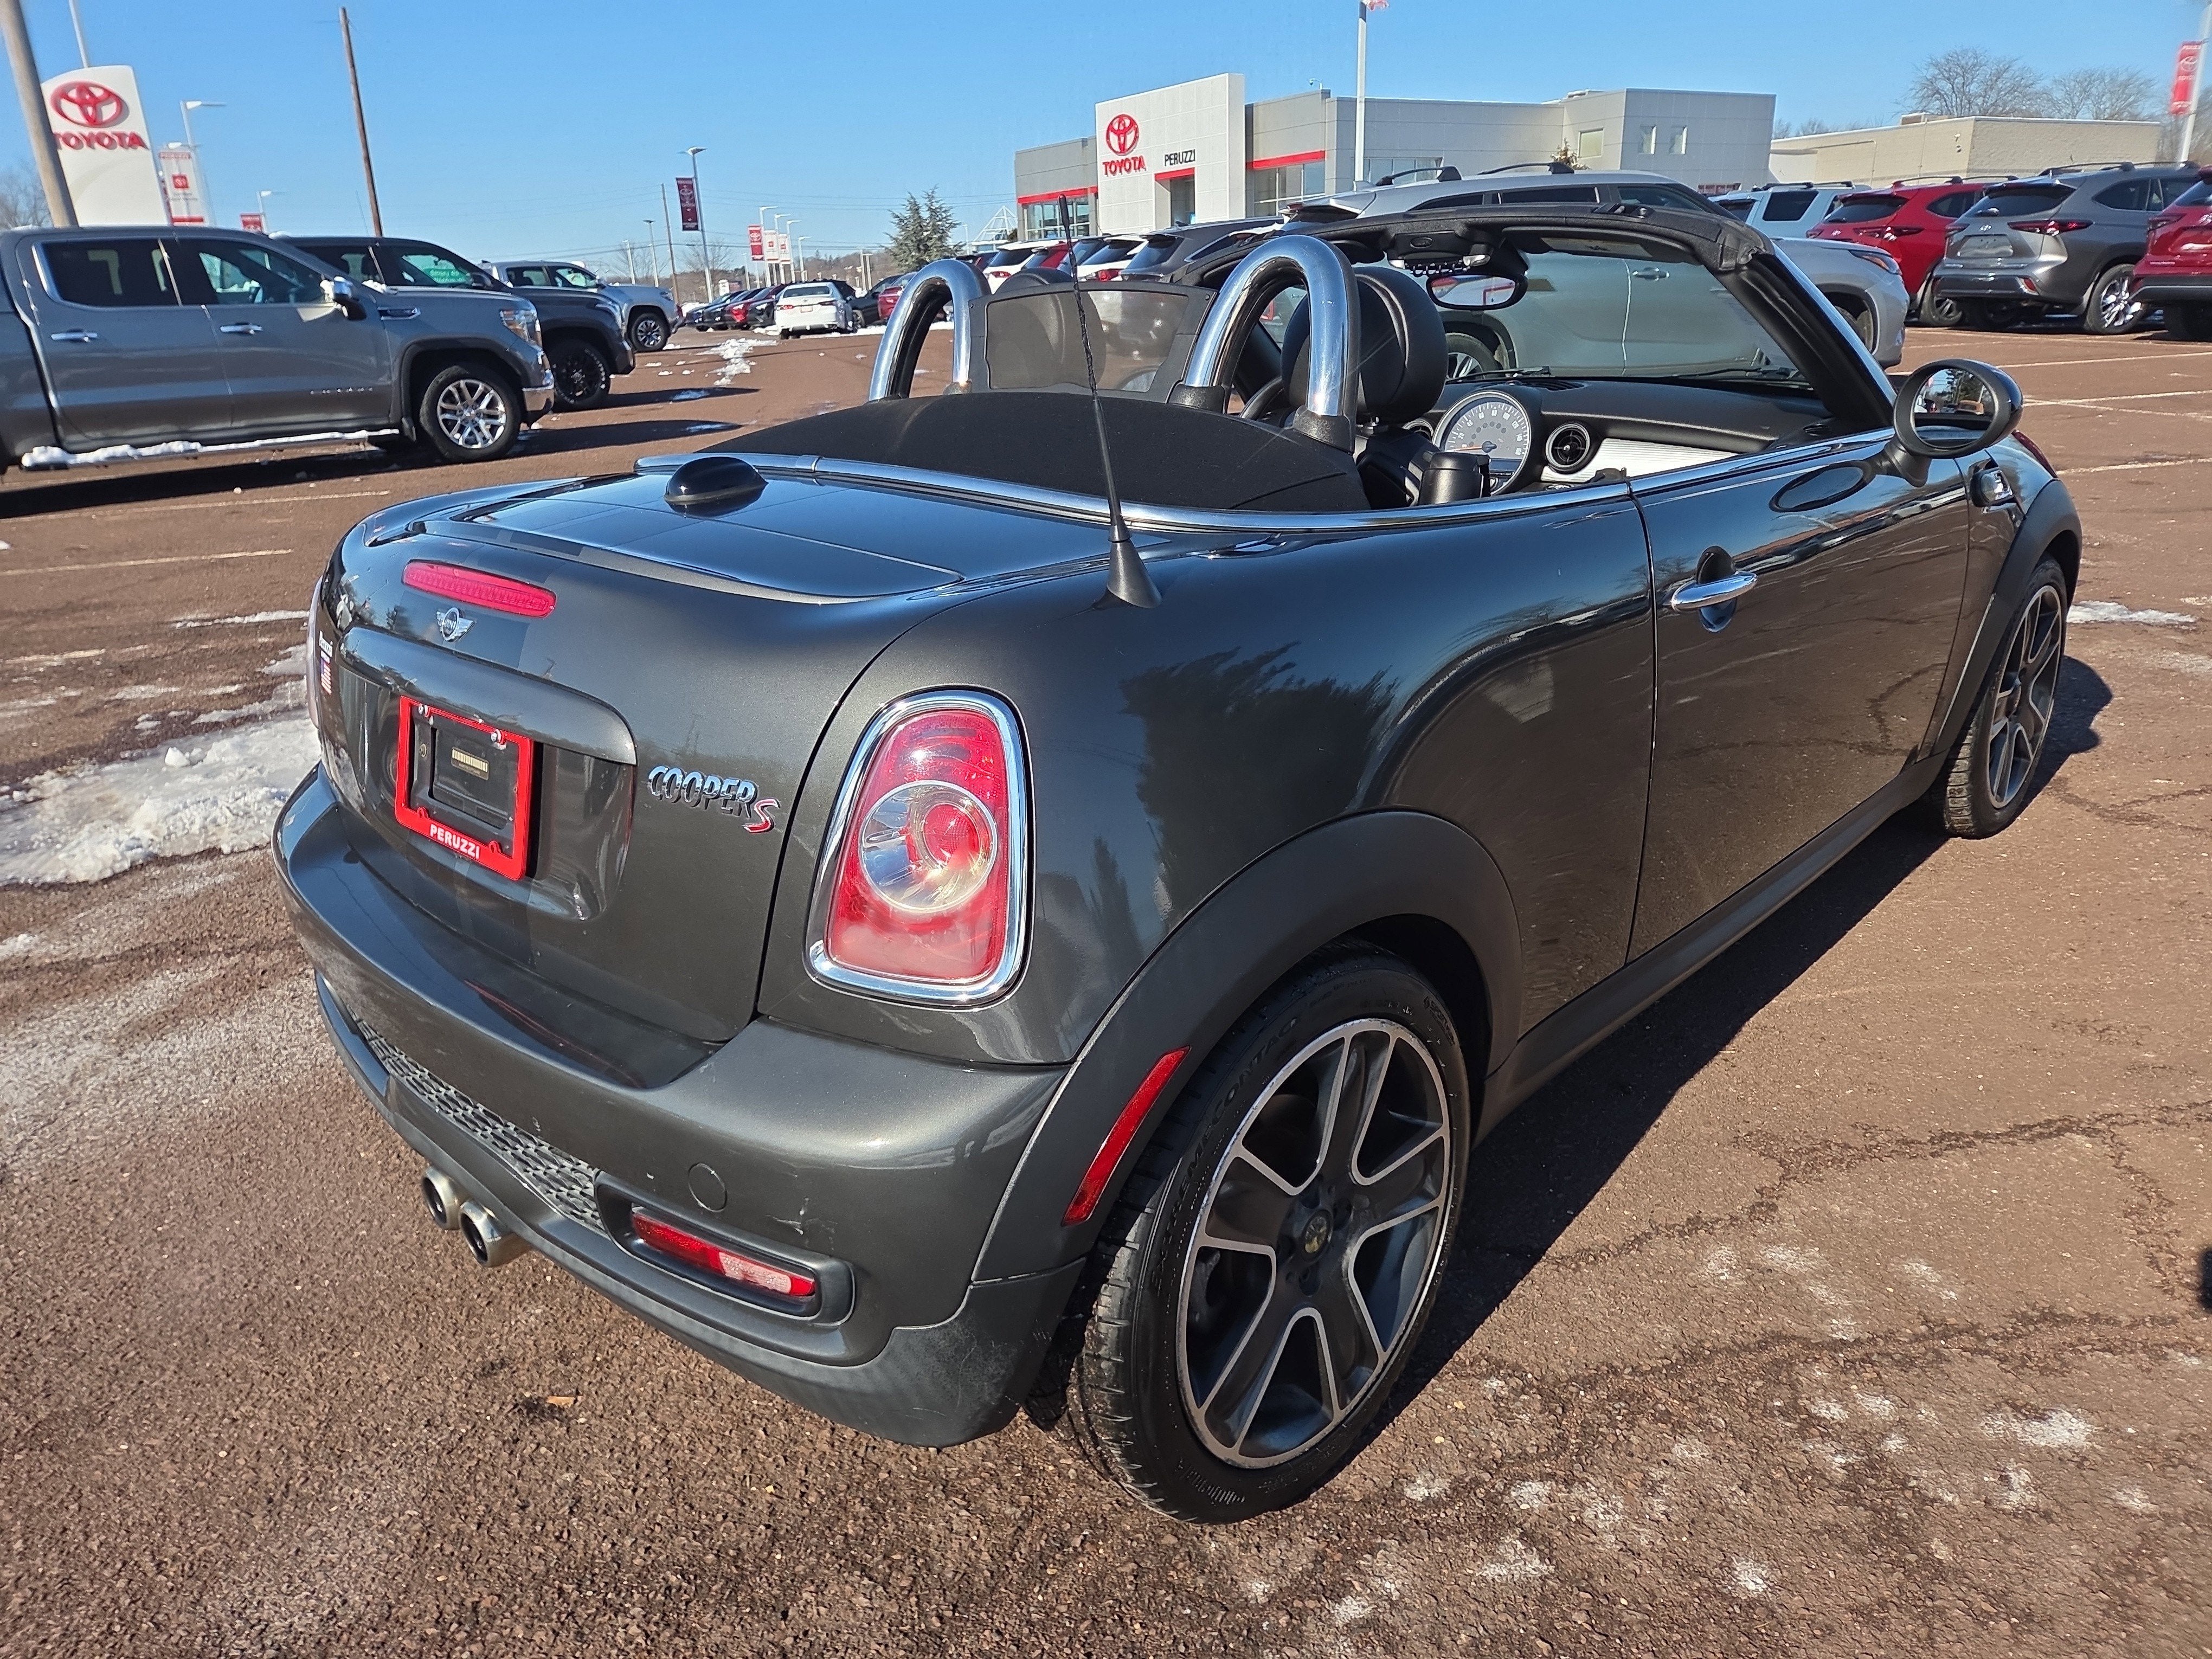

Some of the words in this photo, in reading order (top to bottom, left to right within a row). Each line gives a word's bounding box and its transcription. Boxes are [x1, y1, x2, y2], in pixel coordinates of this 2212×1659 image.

[1103, 156, 1147, 177] TOYOTA
[1165, 149, 1195, 166] PERUZZI
[647, 764, 758, 819] COOPER
[741, 798, 780, 834] S
[430, 824, 480, 859] PERUZZI
